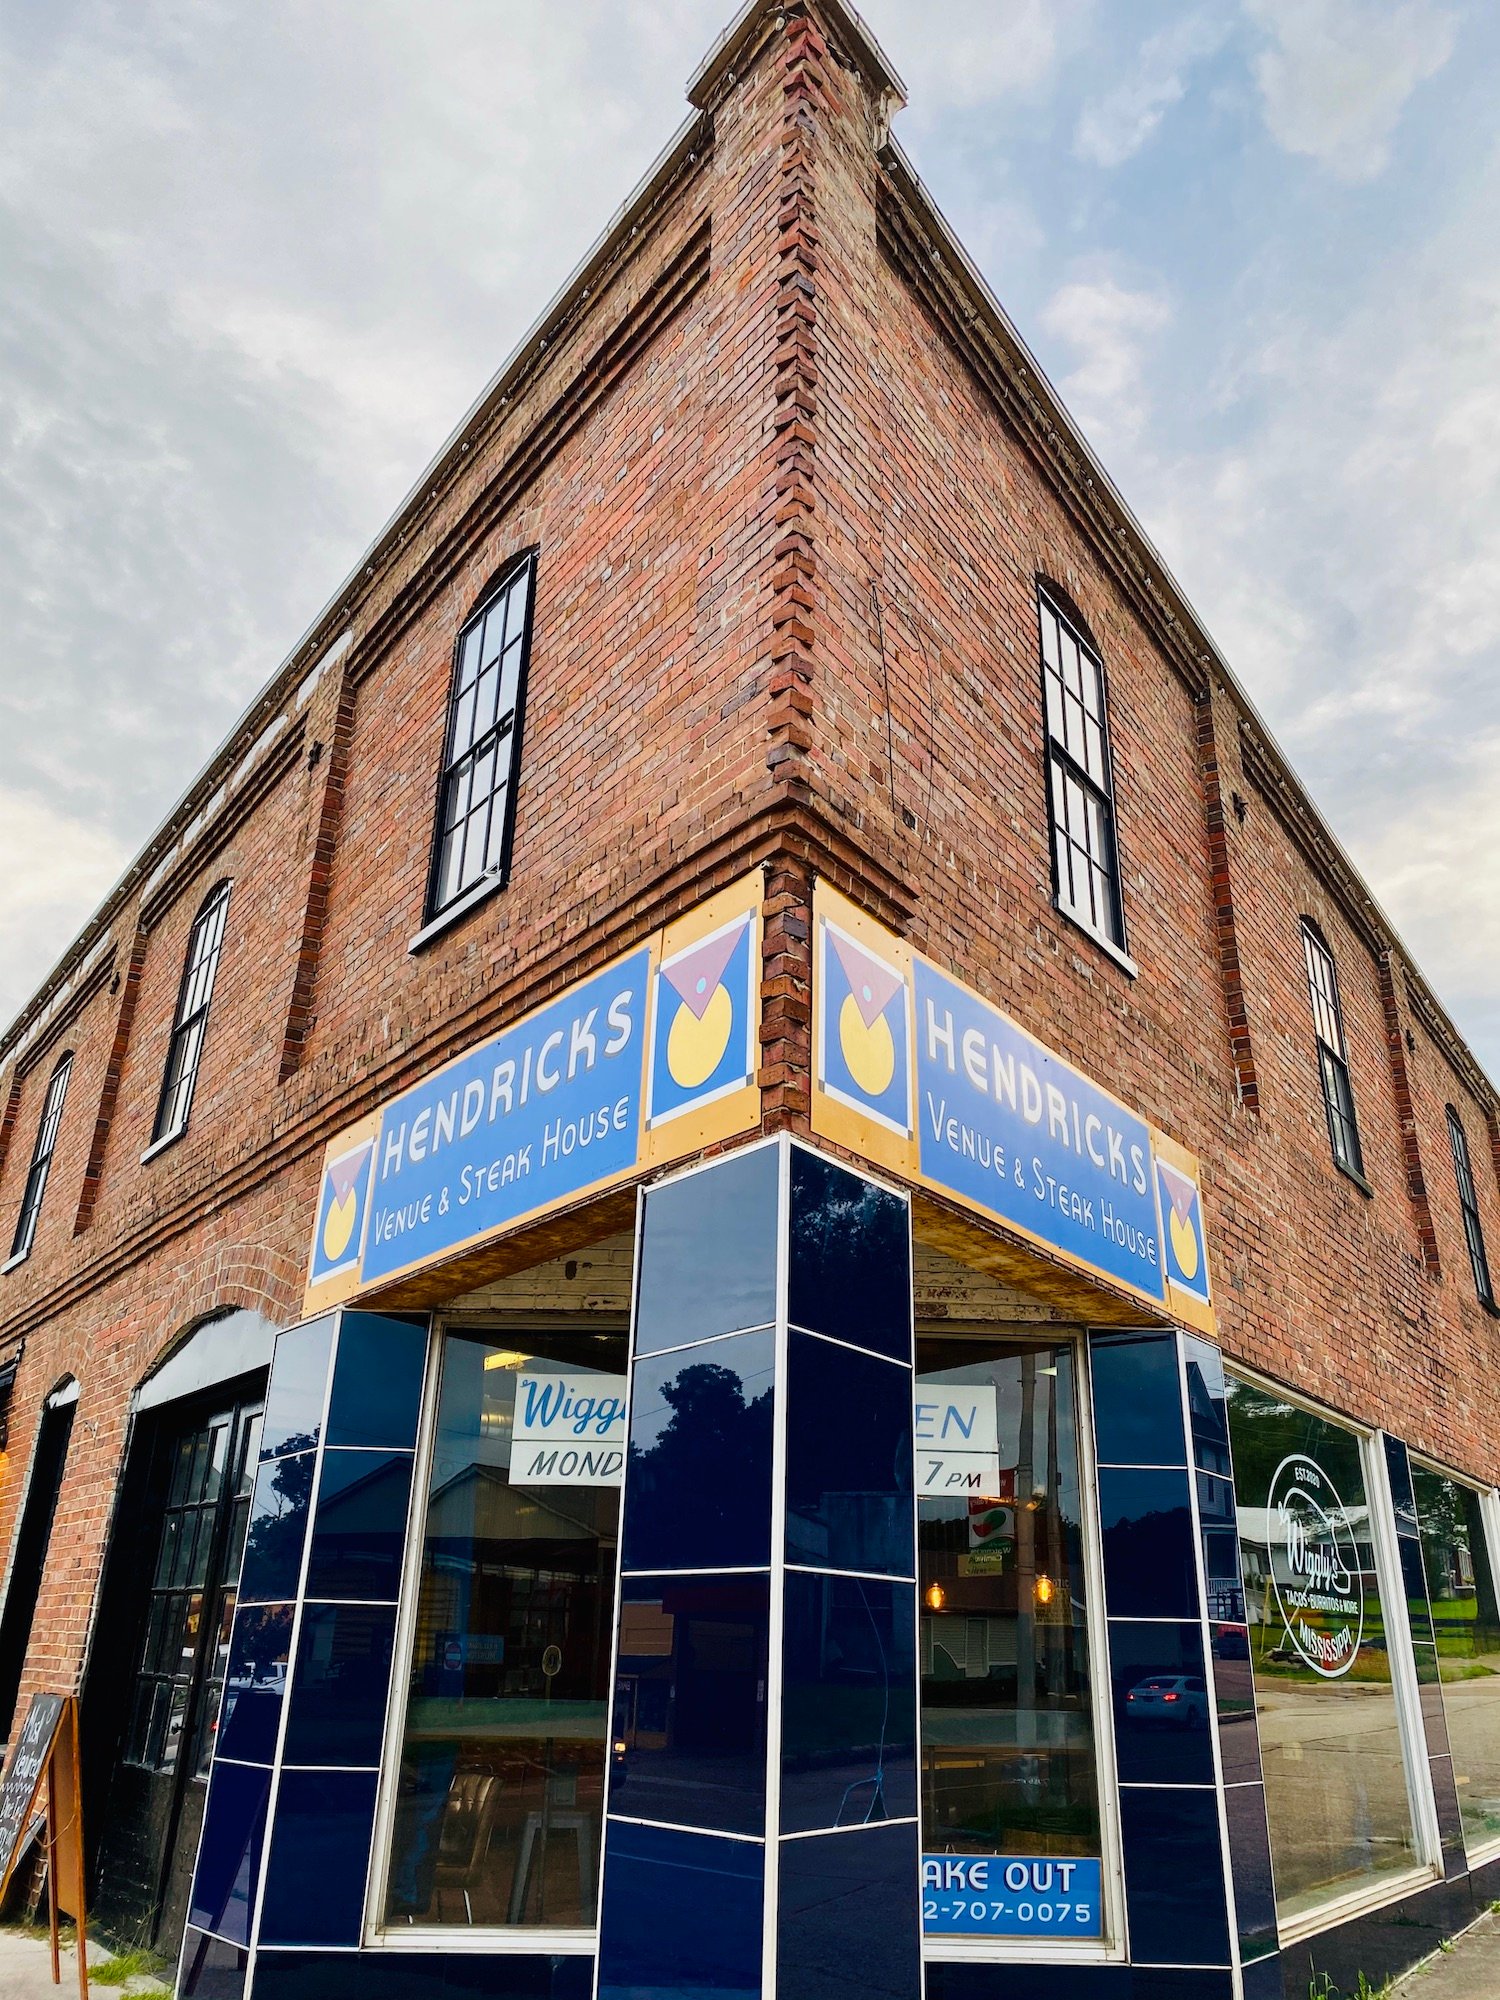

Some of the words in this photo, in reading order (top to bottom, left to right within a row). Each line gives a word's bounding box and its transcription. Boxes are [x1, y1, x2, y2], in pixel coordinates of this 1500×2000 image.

[381, 989, 633, 1181] HENDRICKS
[926, 997, 1147, 1196] HENDRICKS
[1014, 1158, 1026, 1190] &
[437, 1186, 450, 1217] &
[520, 1379, 626, 1435] Wigg
[915, 1404, 977, 1439] EN
[527, 1451, 623, 1477] MOND
[924, 1460, 944, 1486] 7
[945, 1472, 982, 1488] PM
[1300, 1617, 1352, 1663] MISSISSIPPI
[923, 1859, 990, 1892] AKE
[1004, 1861, 1077, 1893] OUT
[923, 1900, 1091, 1923] 2-707-0075
